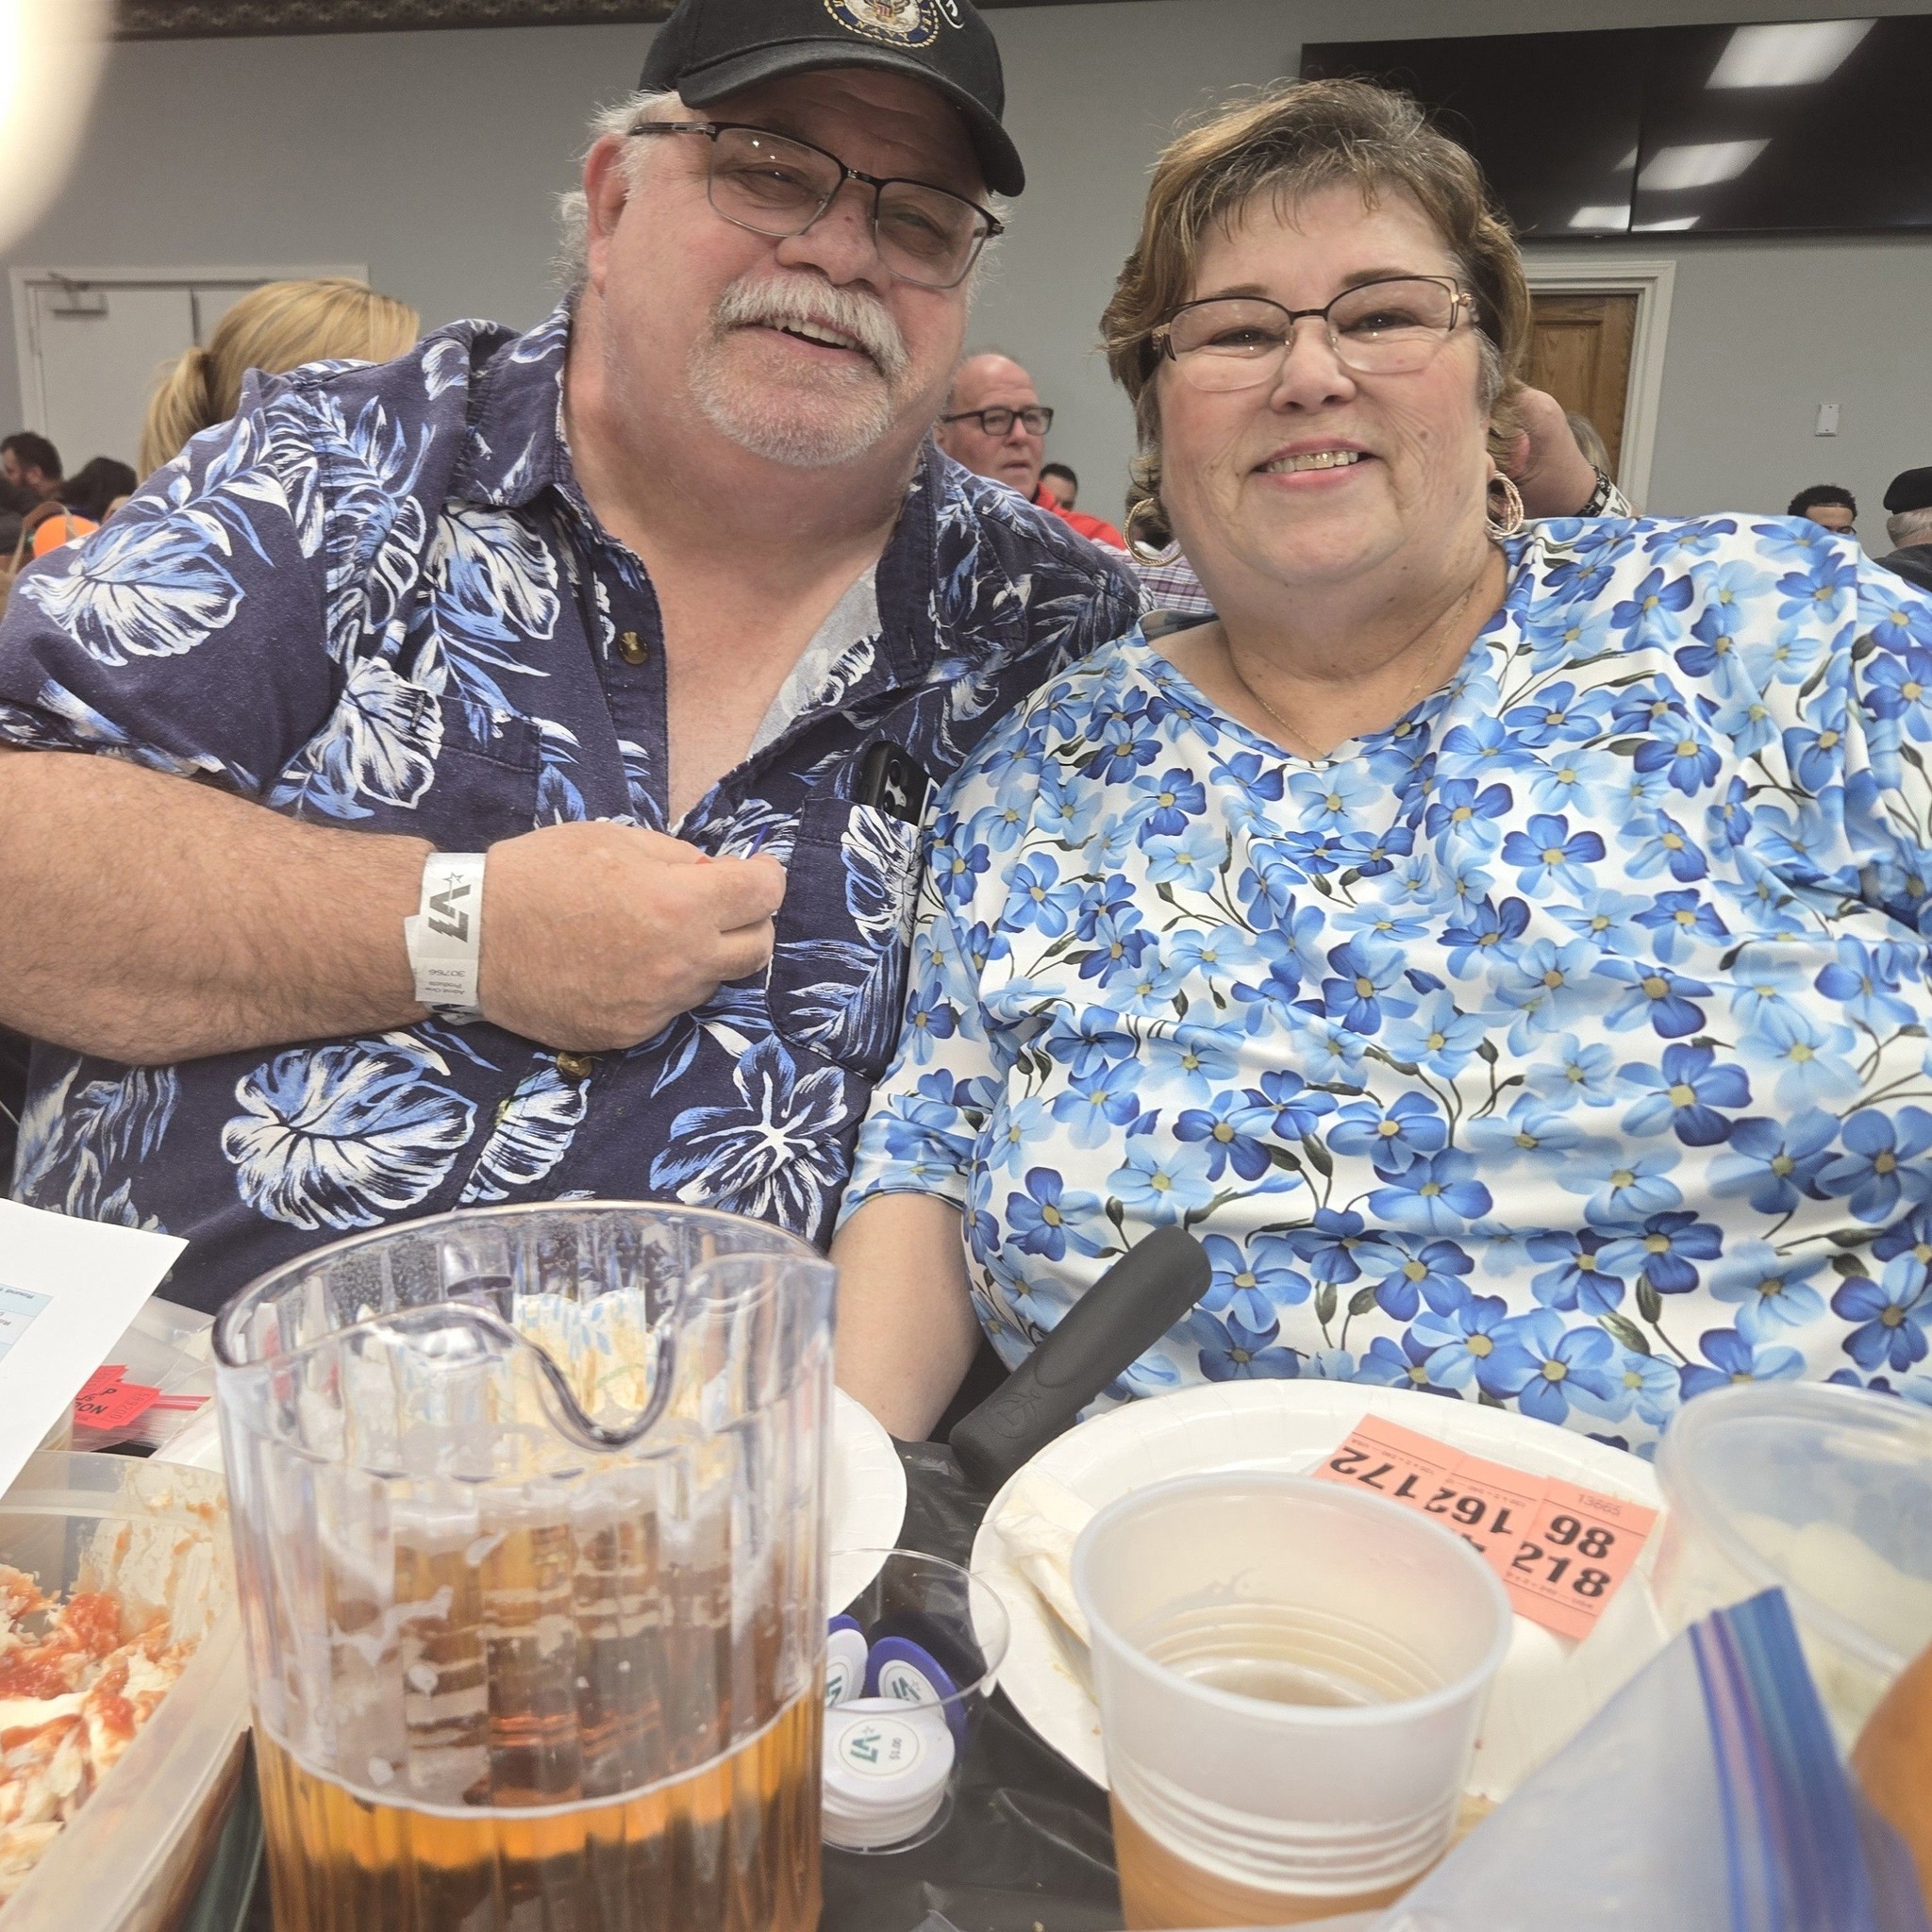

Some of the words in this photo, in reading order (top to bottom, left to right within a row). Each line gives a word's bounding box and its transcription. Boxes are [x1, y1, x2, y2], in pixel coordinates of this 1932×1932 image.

[1329, 1446, 1418, 1499] 172
[1423, 1486, 1514, 1536] 162
[1544, 1514, 1616, 1559] 98
[1511, 1541, 1611, 1598] 218
